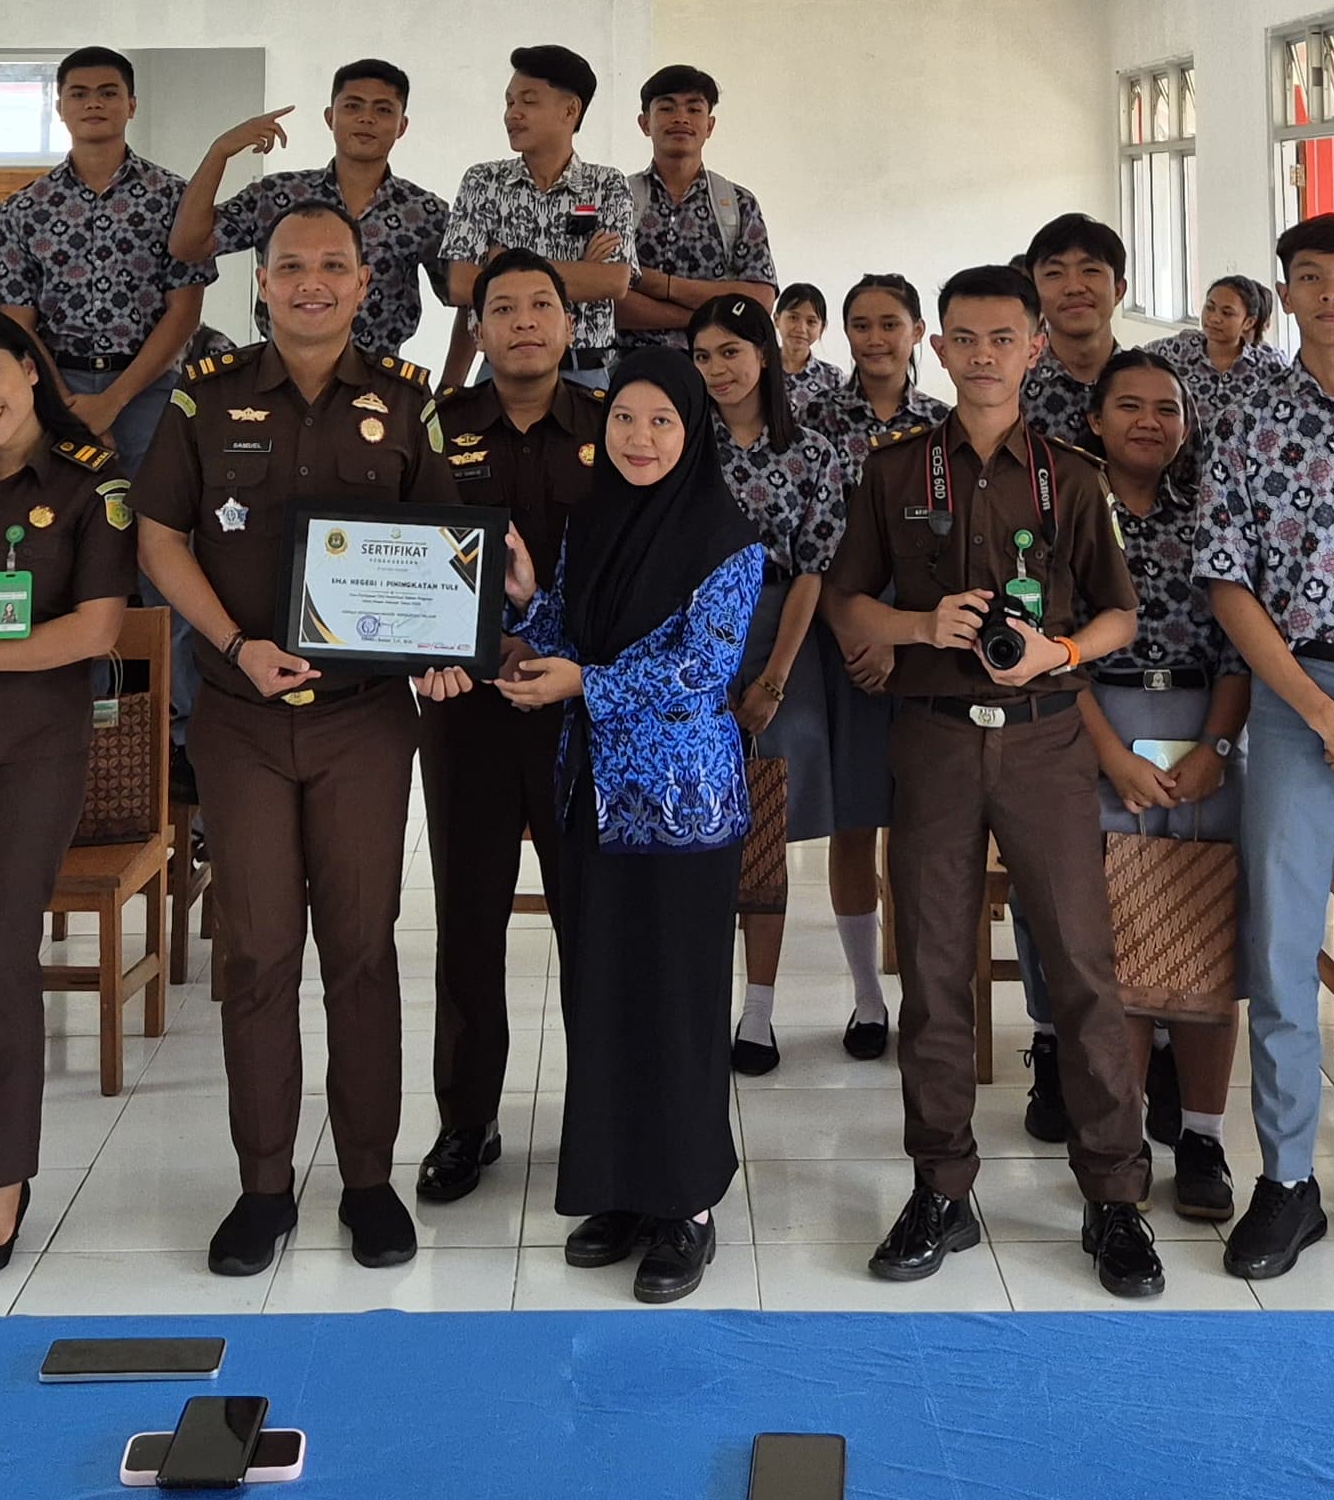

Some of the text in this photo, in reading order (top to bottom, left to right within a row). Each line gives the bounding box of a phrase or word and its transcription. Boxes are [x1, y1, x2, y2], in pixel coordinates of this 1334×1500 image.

[932, 446, 946, 499] EOS 60D
[1038, 468, 1051, 511] Canon
[361, 543, 429, 558] SERTIFIKAT
